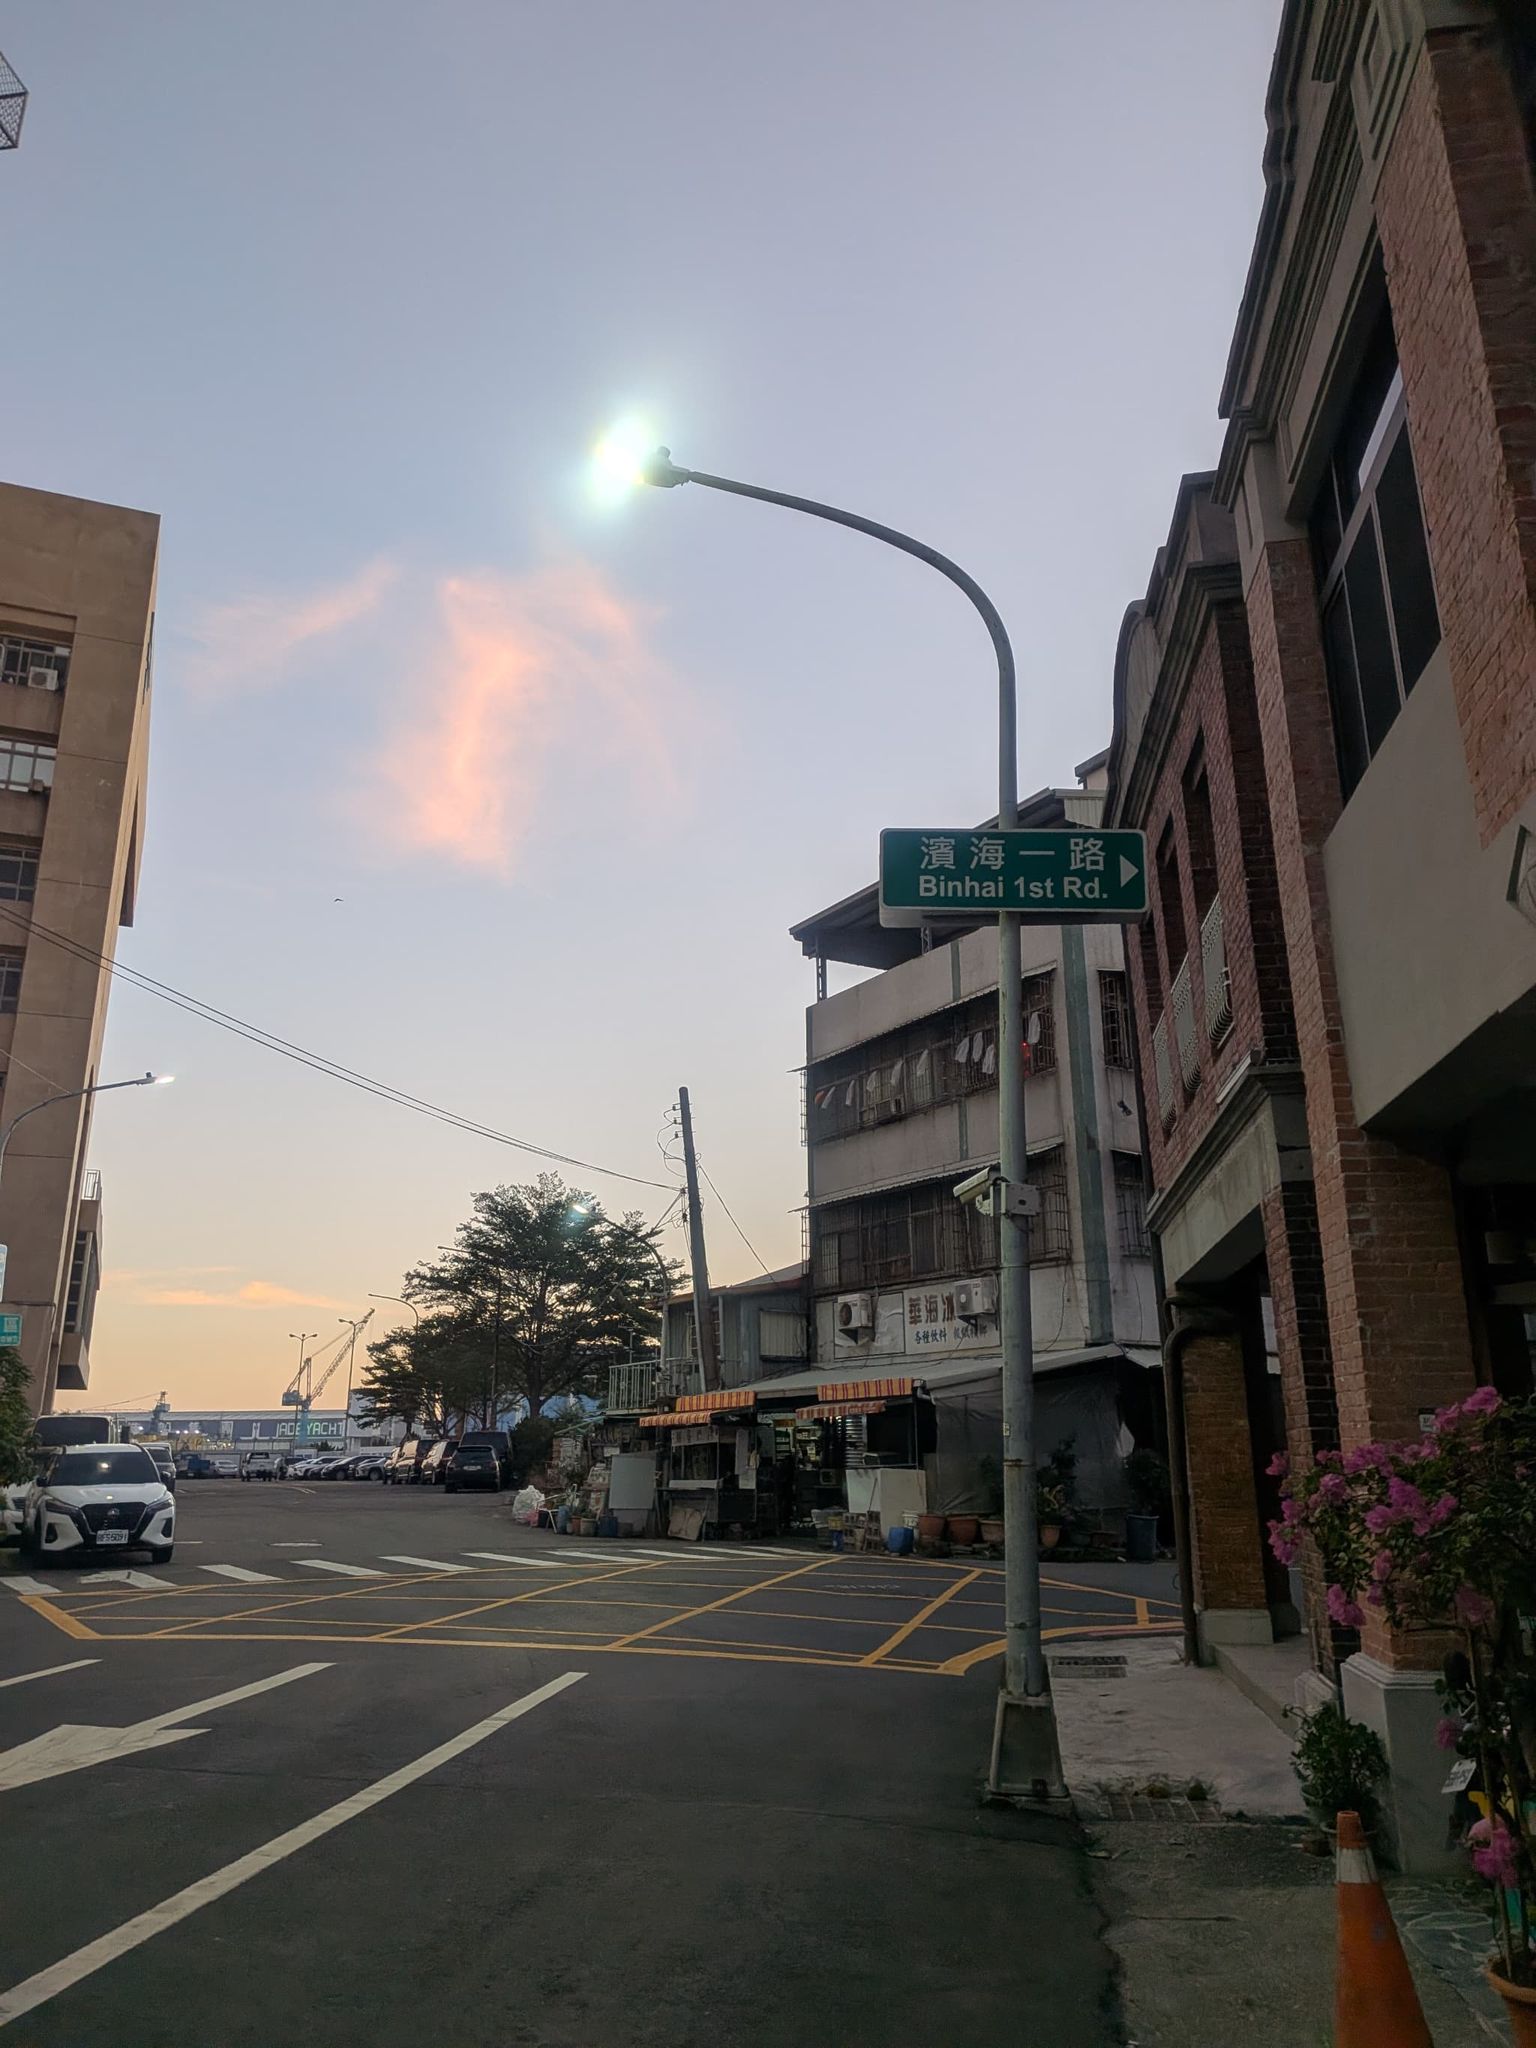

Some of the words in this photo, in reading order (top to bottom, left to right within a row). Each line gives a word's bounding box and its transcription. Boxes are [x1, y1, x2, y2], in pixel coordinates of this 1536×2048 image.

[919, 836, 1106, 871] 濱海一路
[919, 875, 1004, 898] Binhai
[1014, 876, 1055, 899] 1st
[1063, 876, 1108, 899] Rd.
[272, 1422, 301, 1439] JADE
